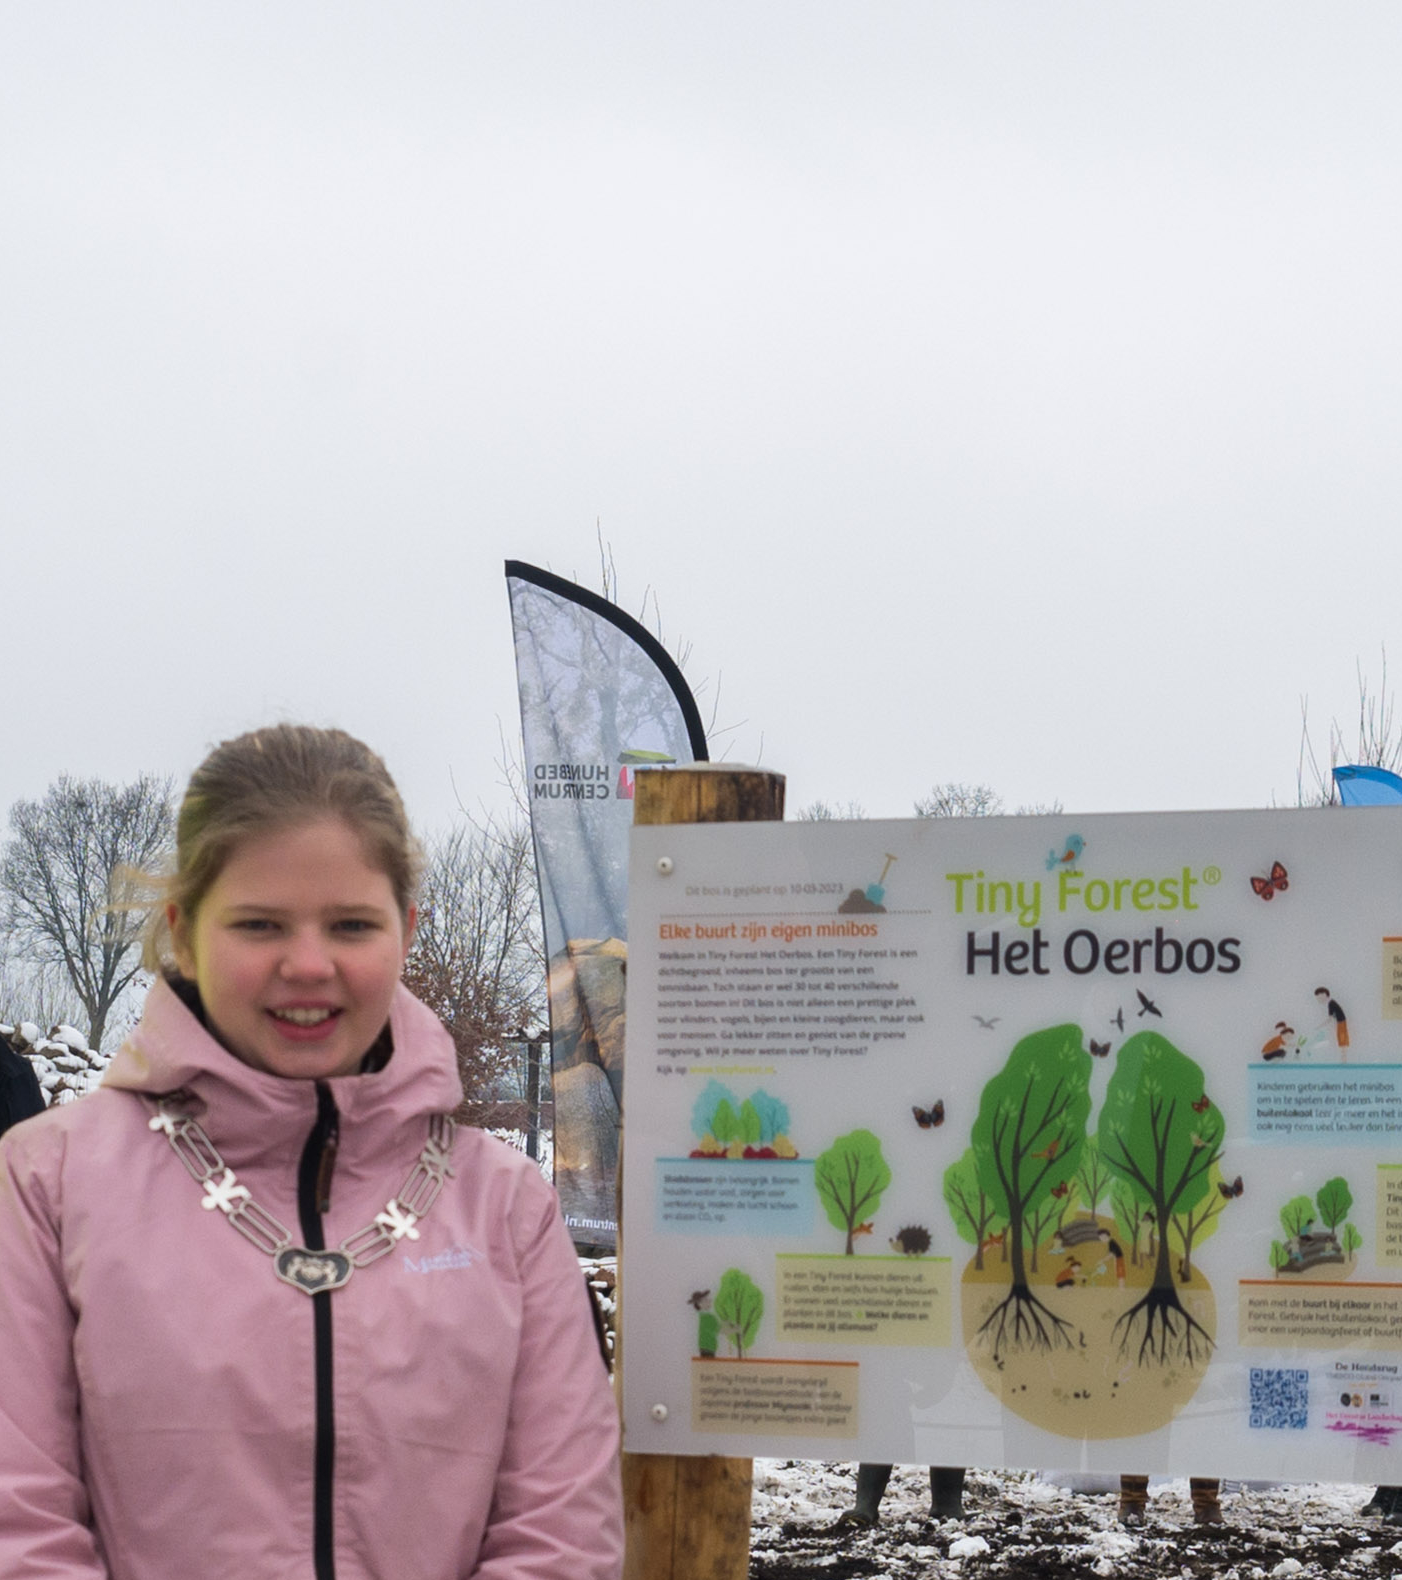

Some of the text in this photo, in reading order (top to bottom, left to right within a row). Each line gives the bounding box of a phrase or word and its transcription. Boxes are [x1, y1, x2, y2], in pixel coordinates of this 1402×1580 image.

[946, 870, 1041, 928] Tiny
[659, 921, 877, 941] Elke buurt zijn eigen minibos
[966, 926, 1242, 975] Het Oerbos
